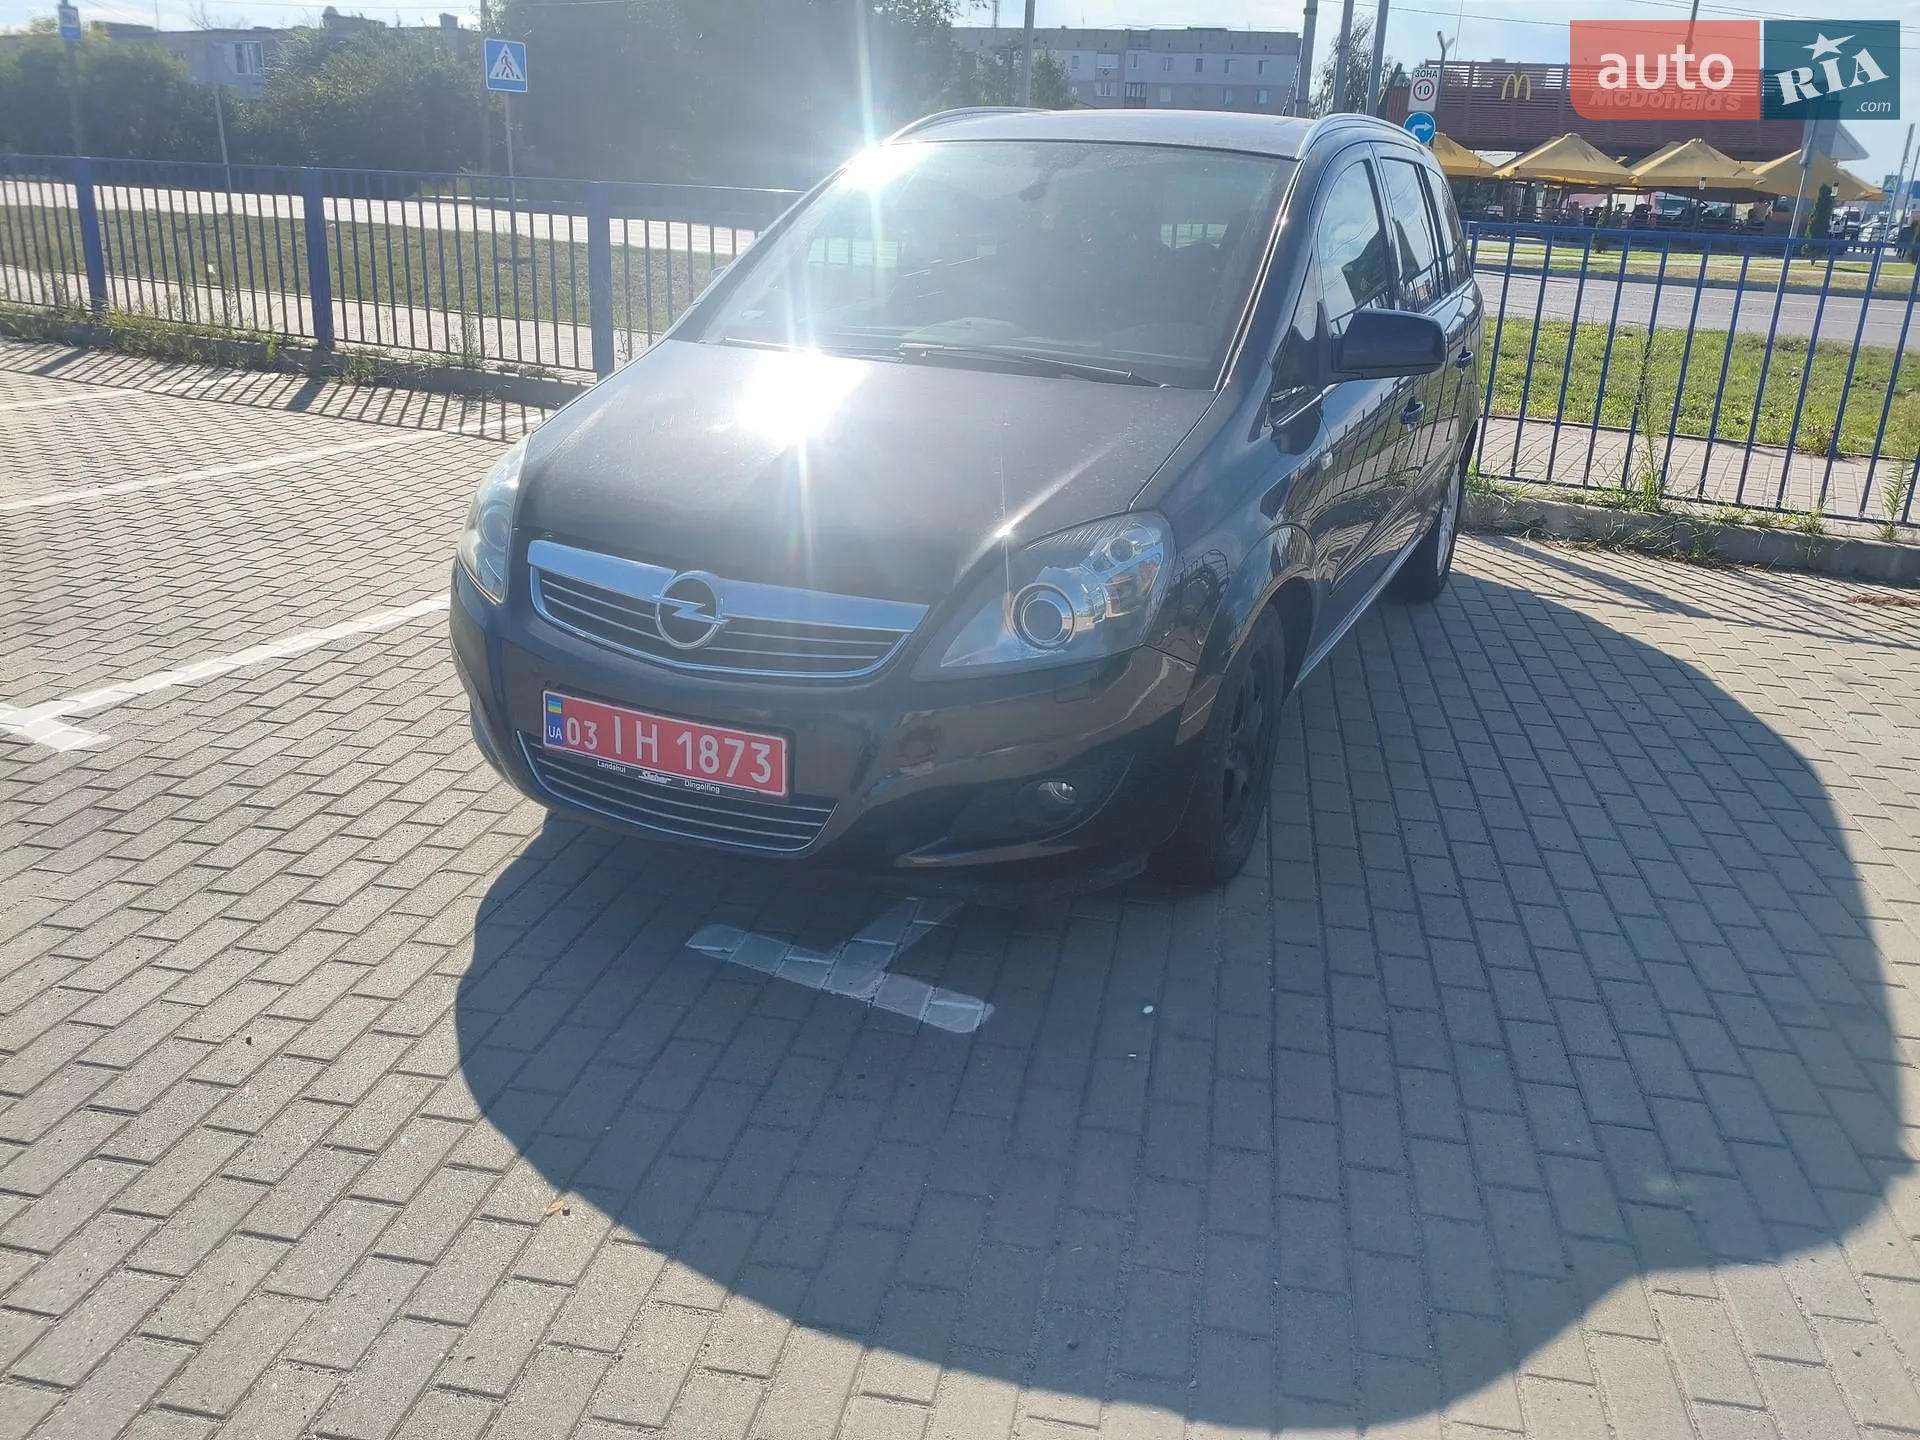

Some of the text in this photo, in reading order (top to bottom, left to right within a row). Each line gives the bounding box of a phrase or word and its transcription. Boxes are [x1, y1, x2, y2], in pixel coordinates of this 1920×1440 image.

[1414, 69, 1438, 79] ЗОНА
[1417, 85, 1430, 95] 10
[1589, 89, 1742, 111] McDonald's
[548, 725, 563, 741] UA
[566, 715, 772, 784] 03 IH 1873
